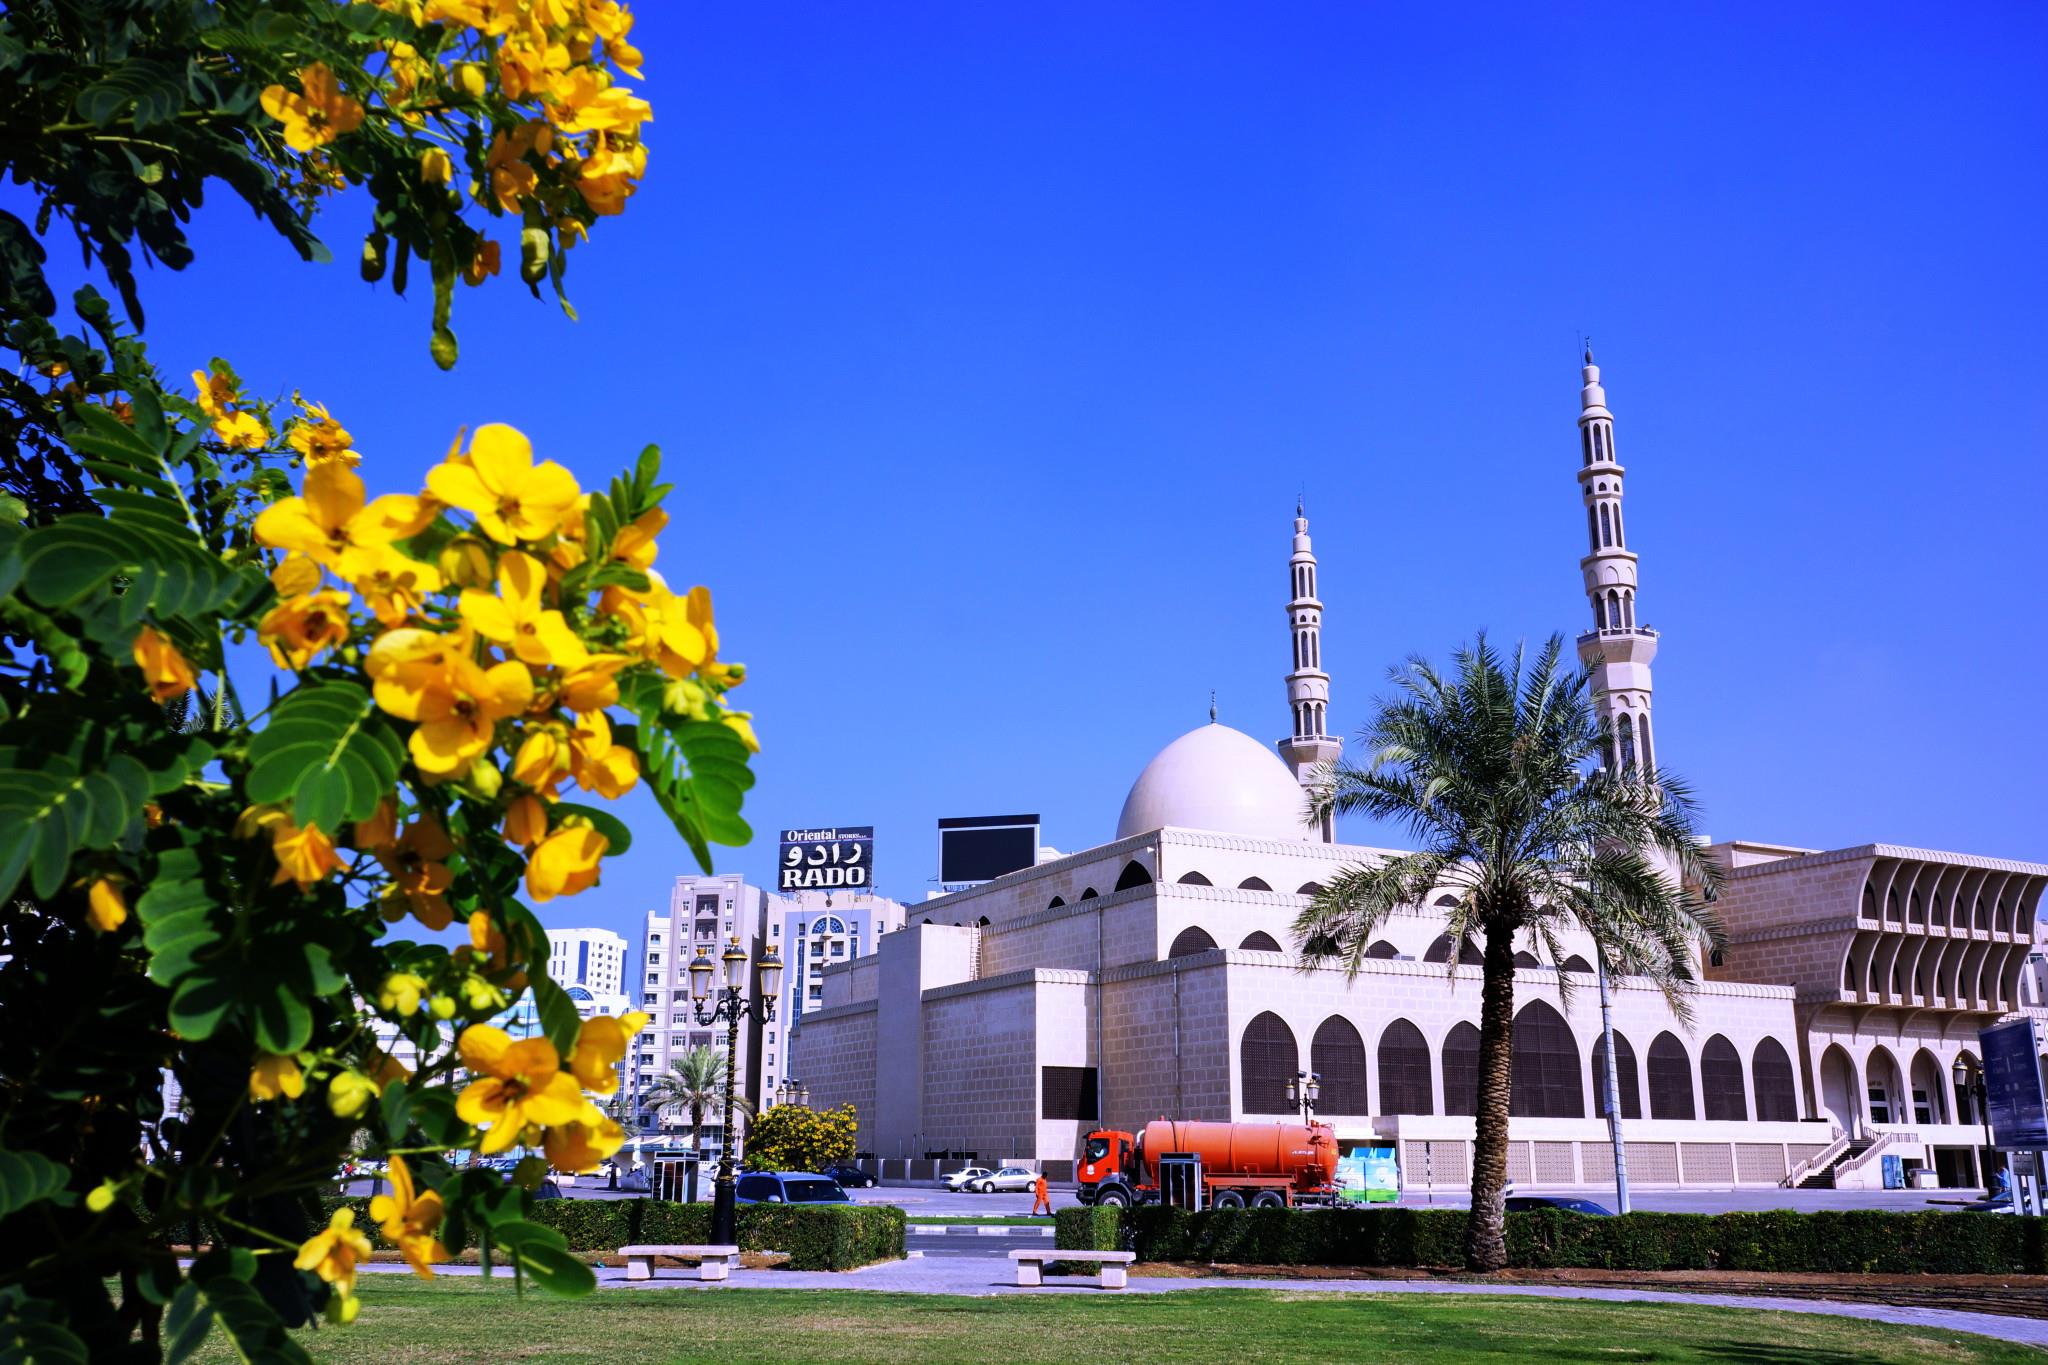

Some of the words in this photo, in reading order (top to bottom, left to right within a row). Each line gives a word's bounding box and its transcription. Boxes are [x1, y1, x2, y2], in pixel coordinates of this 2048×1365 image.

[787, 829, 836, 841] Oriental
[784, 842, 862, 867] رادو
[782, 866, 865, 888] RADO
